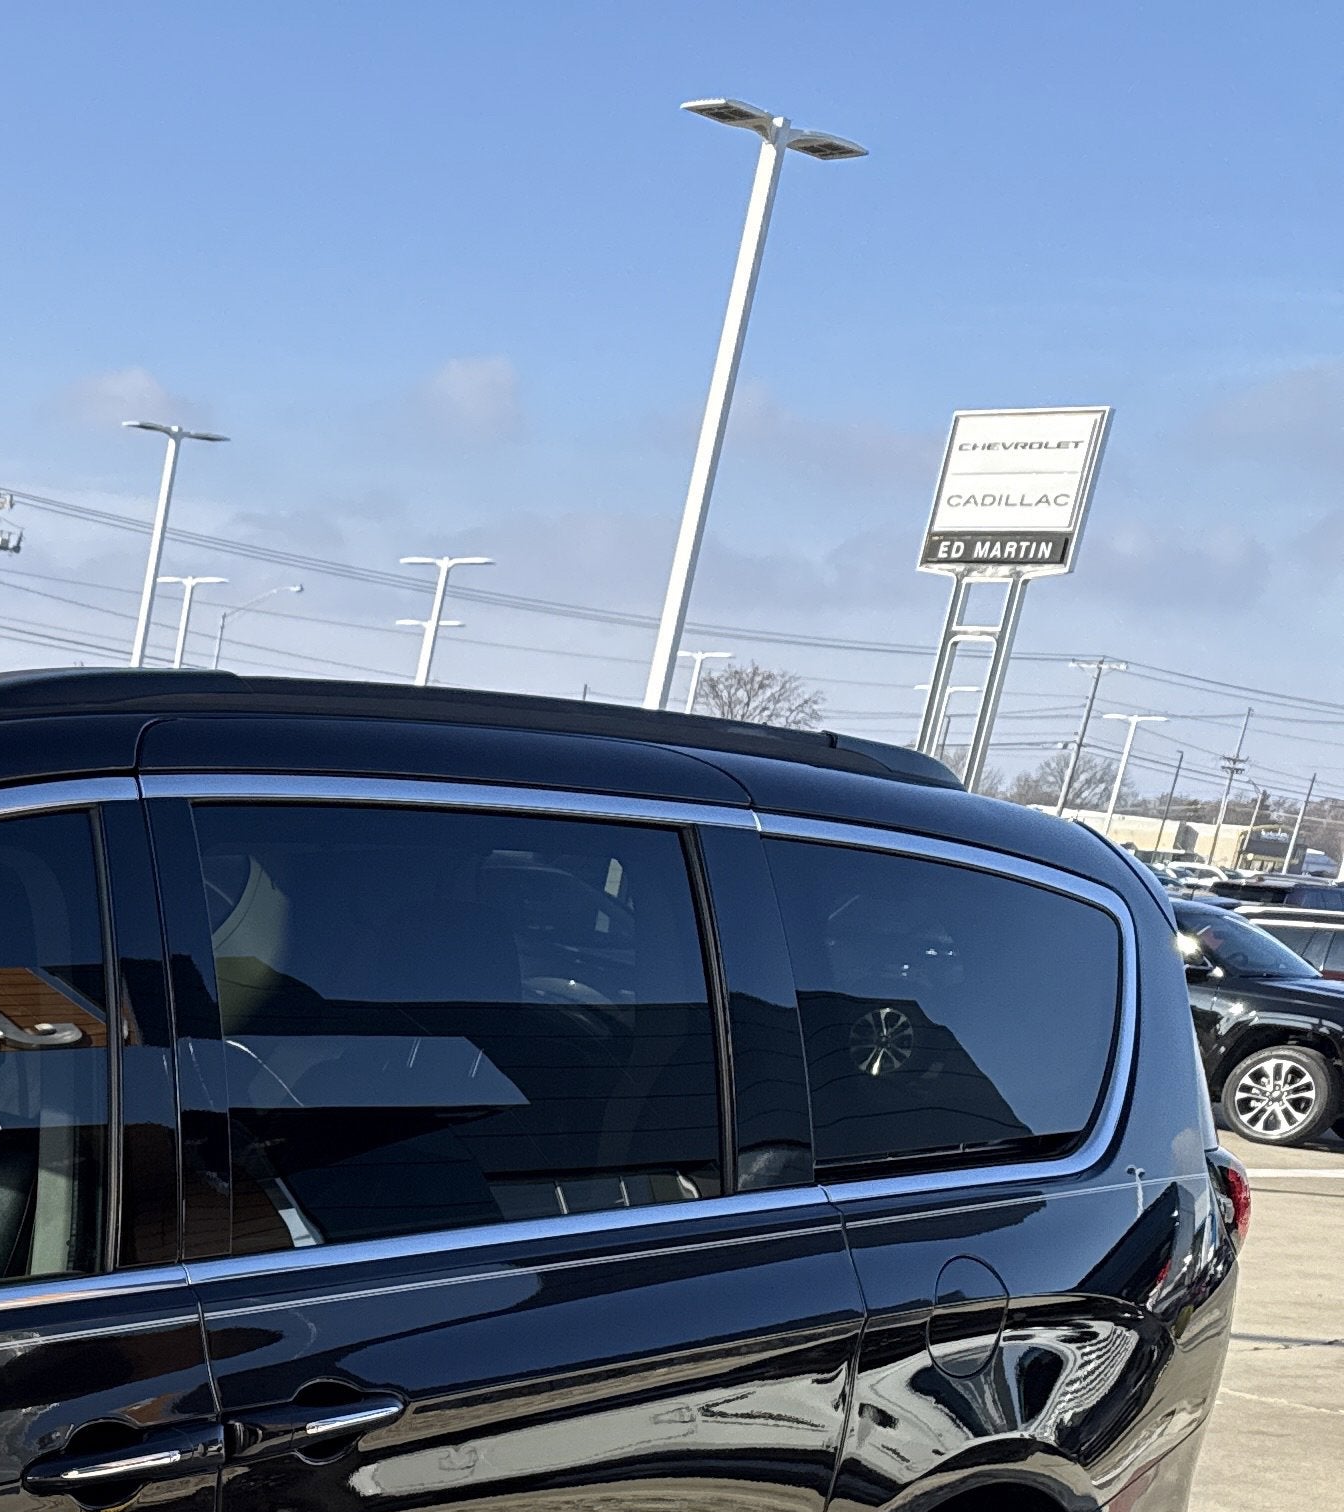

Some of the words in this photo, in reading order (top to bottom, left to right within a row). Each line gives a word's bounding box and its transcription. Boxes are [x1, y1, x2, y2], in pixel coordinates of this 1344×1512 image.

[958, 440, 1084, 451] CHEVROLET
[946, 494, 1070, 507] CADILLAC
[937, 541, 965, 559] ED
[973, 541, 1053, 559] MARTIN
